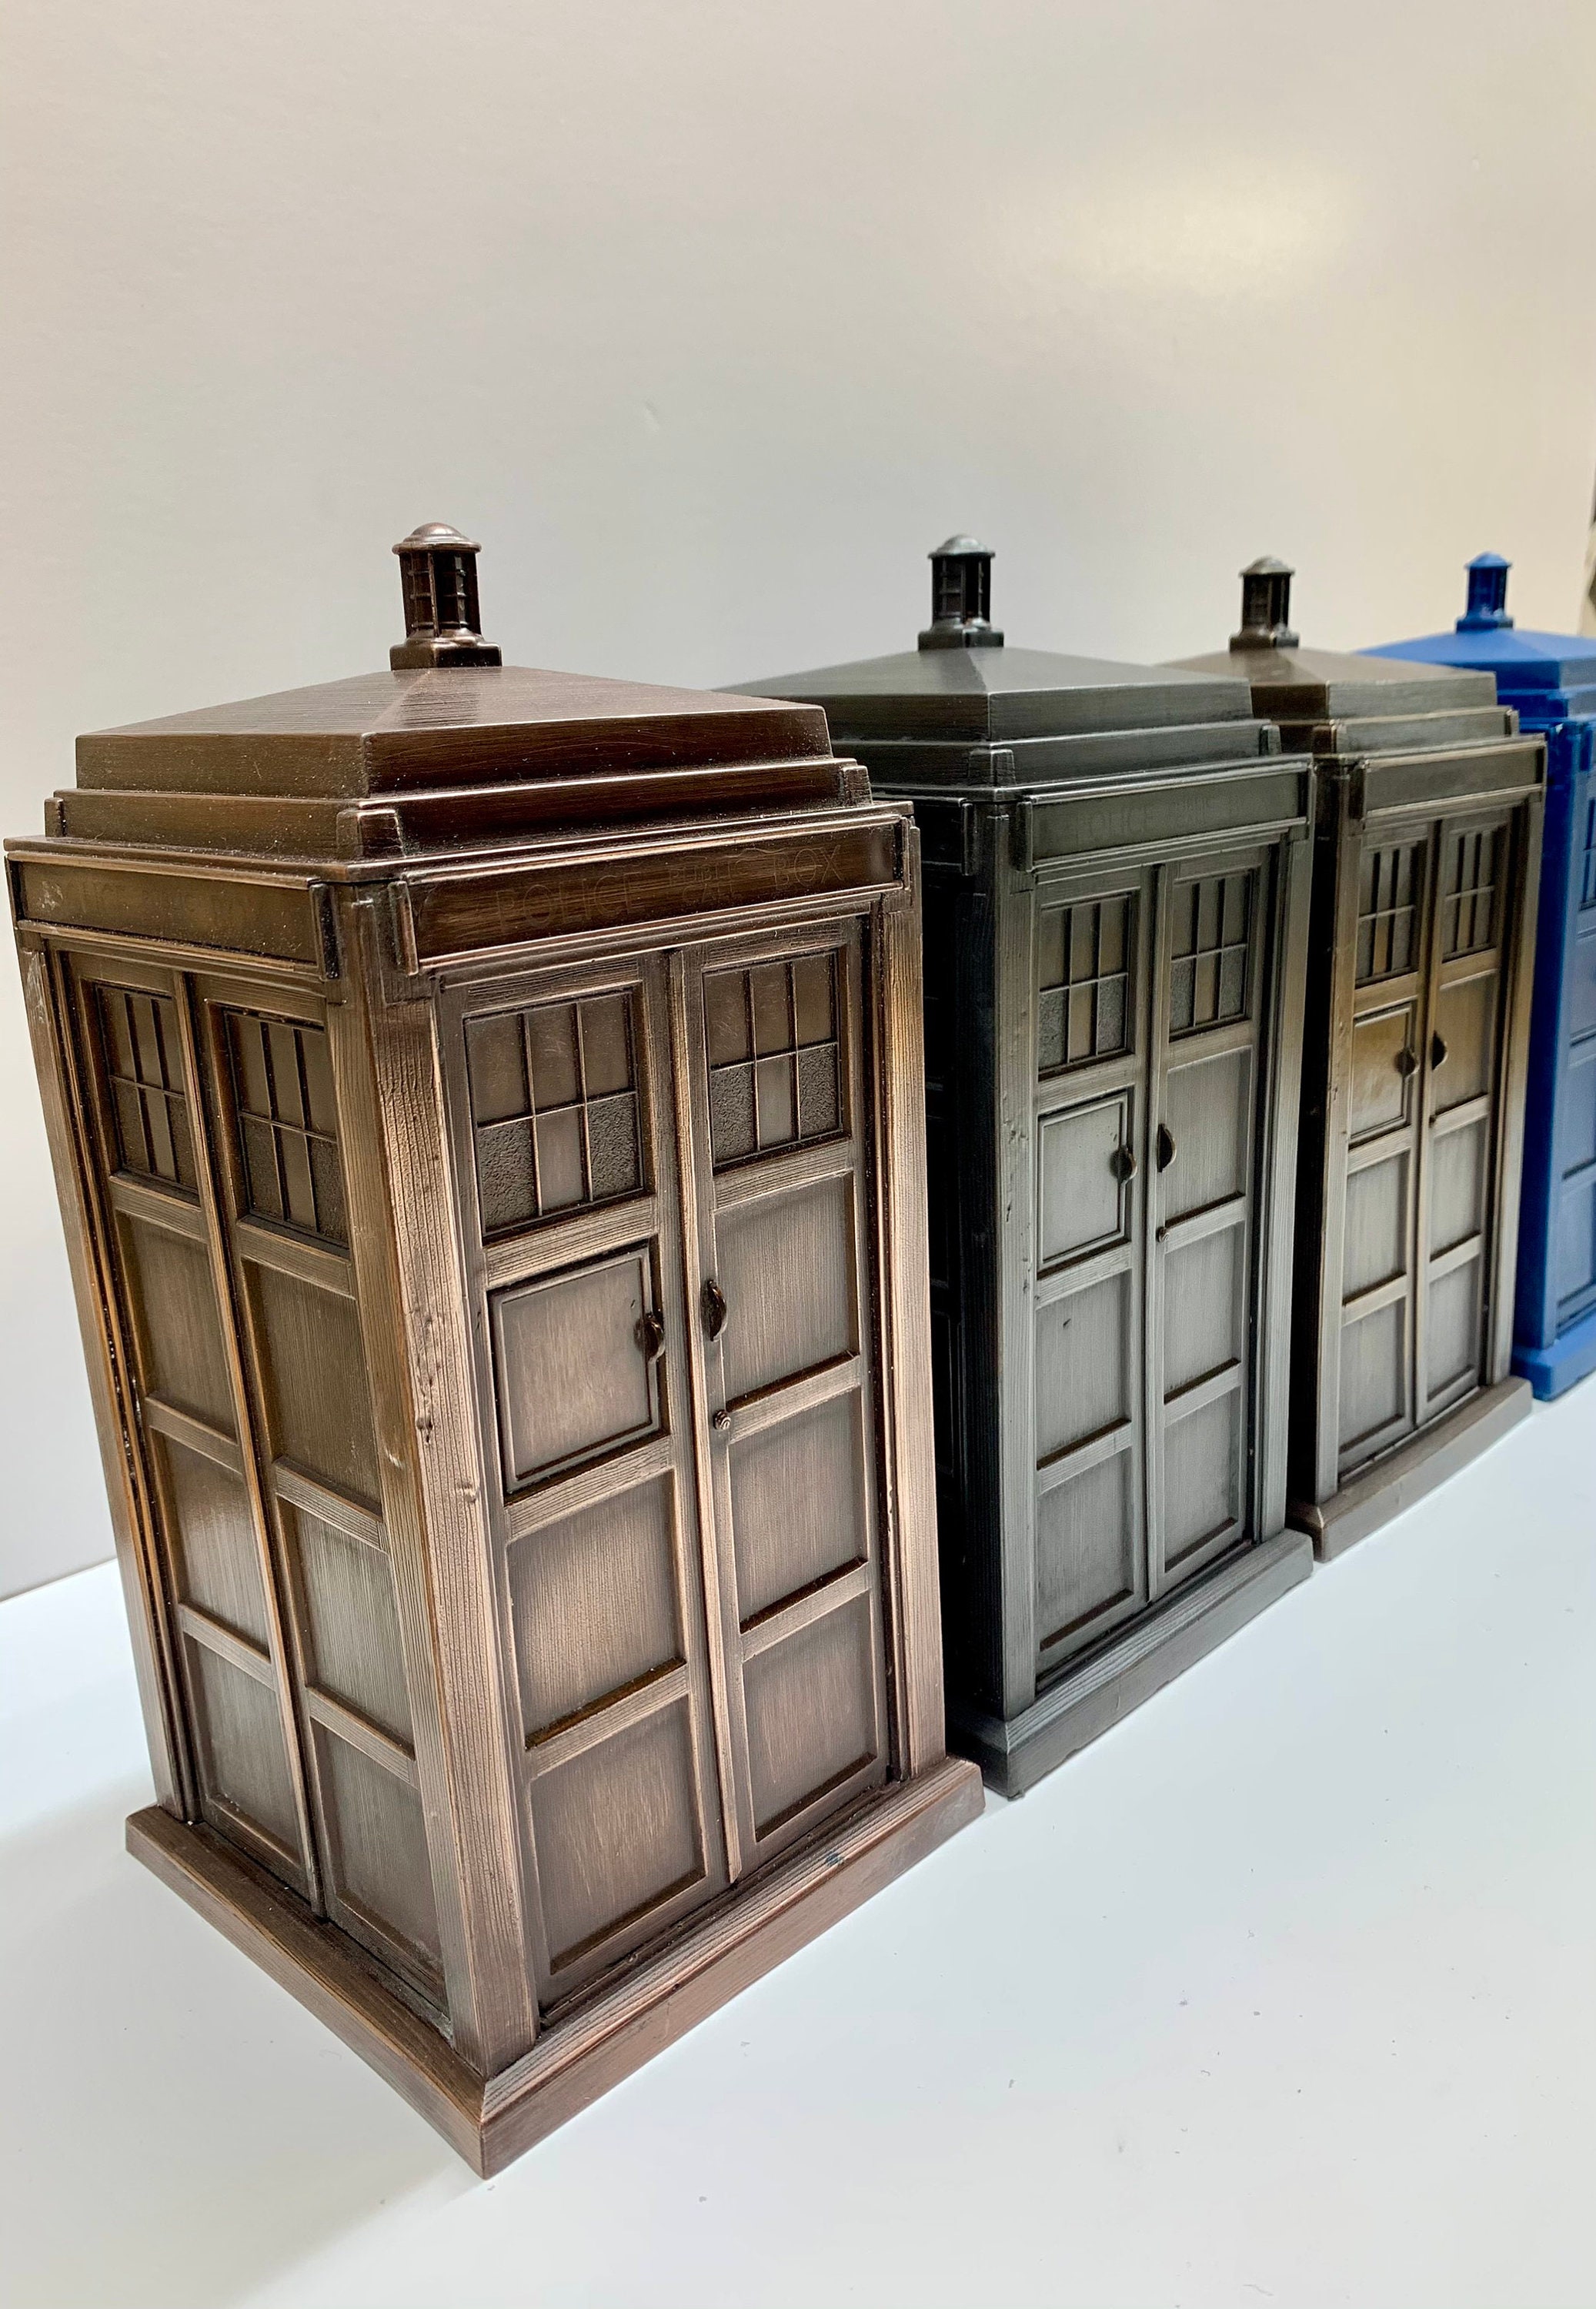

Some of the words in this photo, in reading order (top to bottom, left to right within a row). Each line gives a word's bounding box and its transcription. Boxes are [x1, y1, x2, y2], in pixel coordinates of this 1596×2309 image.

[668, 858, 752, 887] PUBLIC
[773, 844, 845, 891] BOX
[495, 870, 643, 933] POLICE
